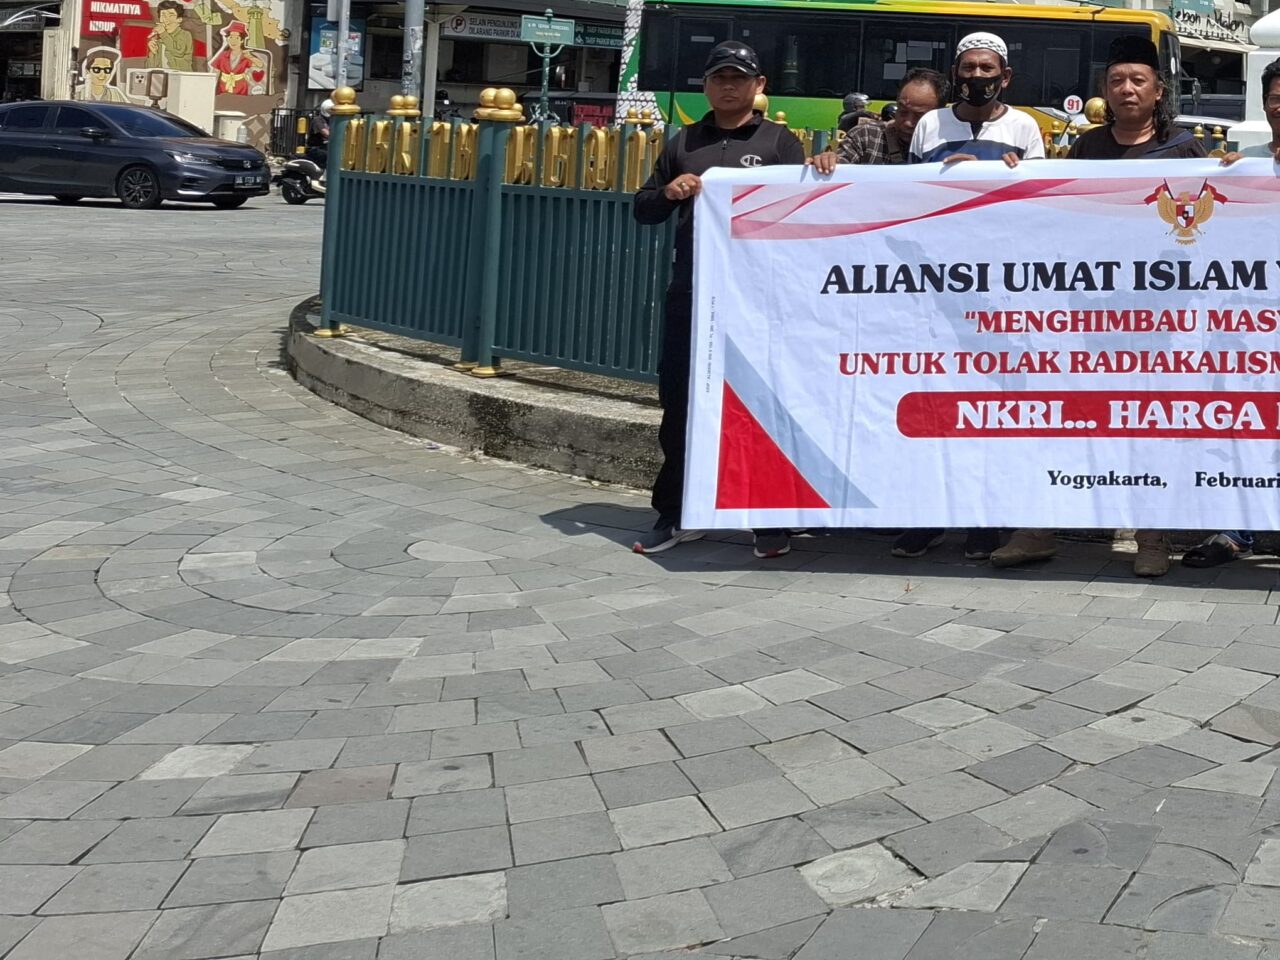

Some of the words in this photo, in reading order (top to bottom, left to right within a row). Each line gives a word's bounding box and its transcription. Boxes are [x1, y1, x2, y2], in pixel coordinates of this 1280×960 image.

[90, 1, 141, 16] NIKMATNYA
[1067, 99, 1080, 111] 91
[820, 263, 990, 295] ALIANSI
[1002, 261, 1121, 292] UMAT
[1133, 260, 1267, 291] ISLAM
[963, 309, 1197, 333] "MENGHIMBAU
[838, 352, 946, 376] UNTUK
[955, 351, 1060, 375] TOLAK
[955, 400, 1098, 430] NKRI...
[1108, 400, 1266, 431] HARGA
[1048, 470, 1168, 490] Yogyakarta,
